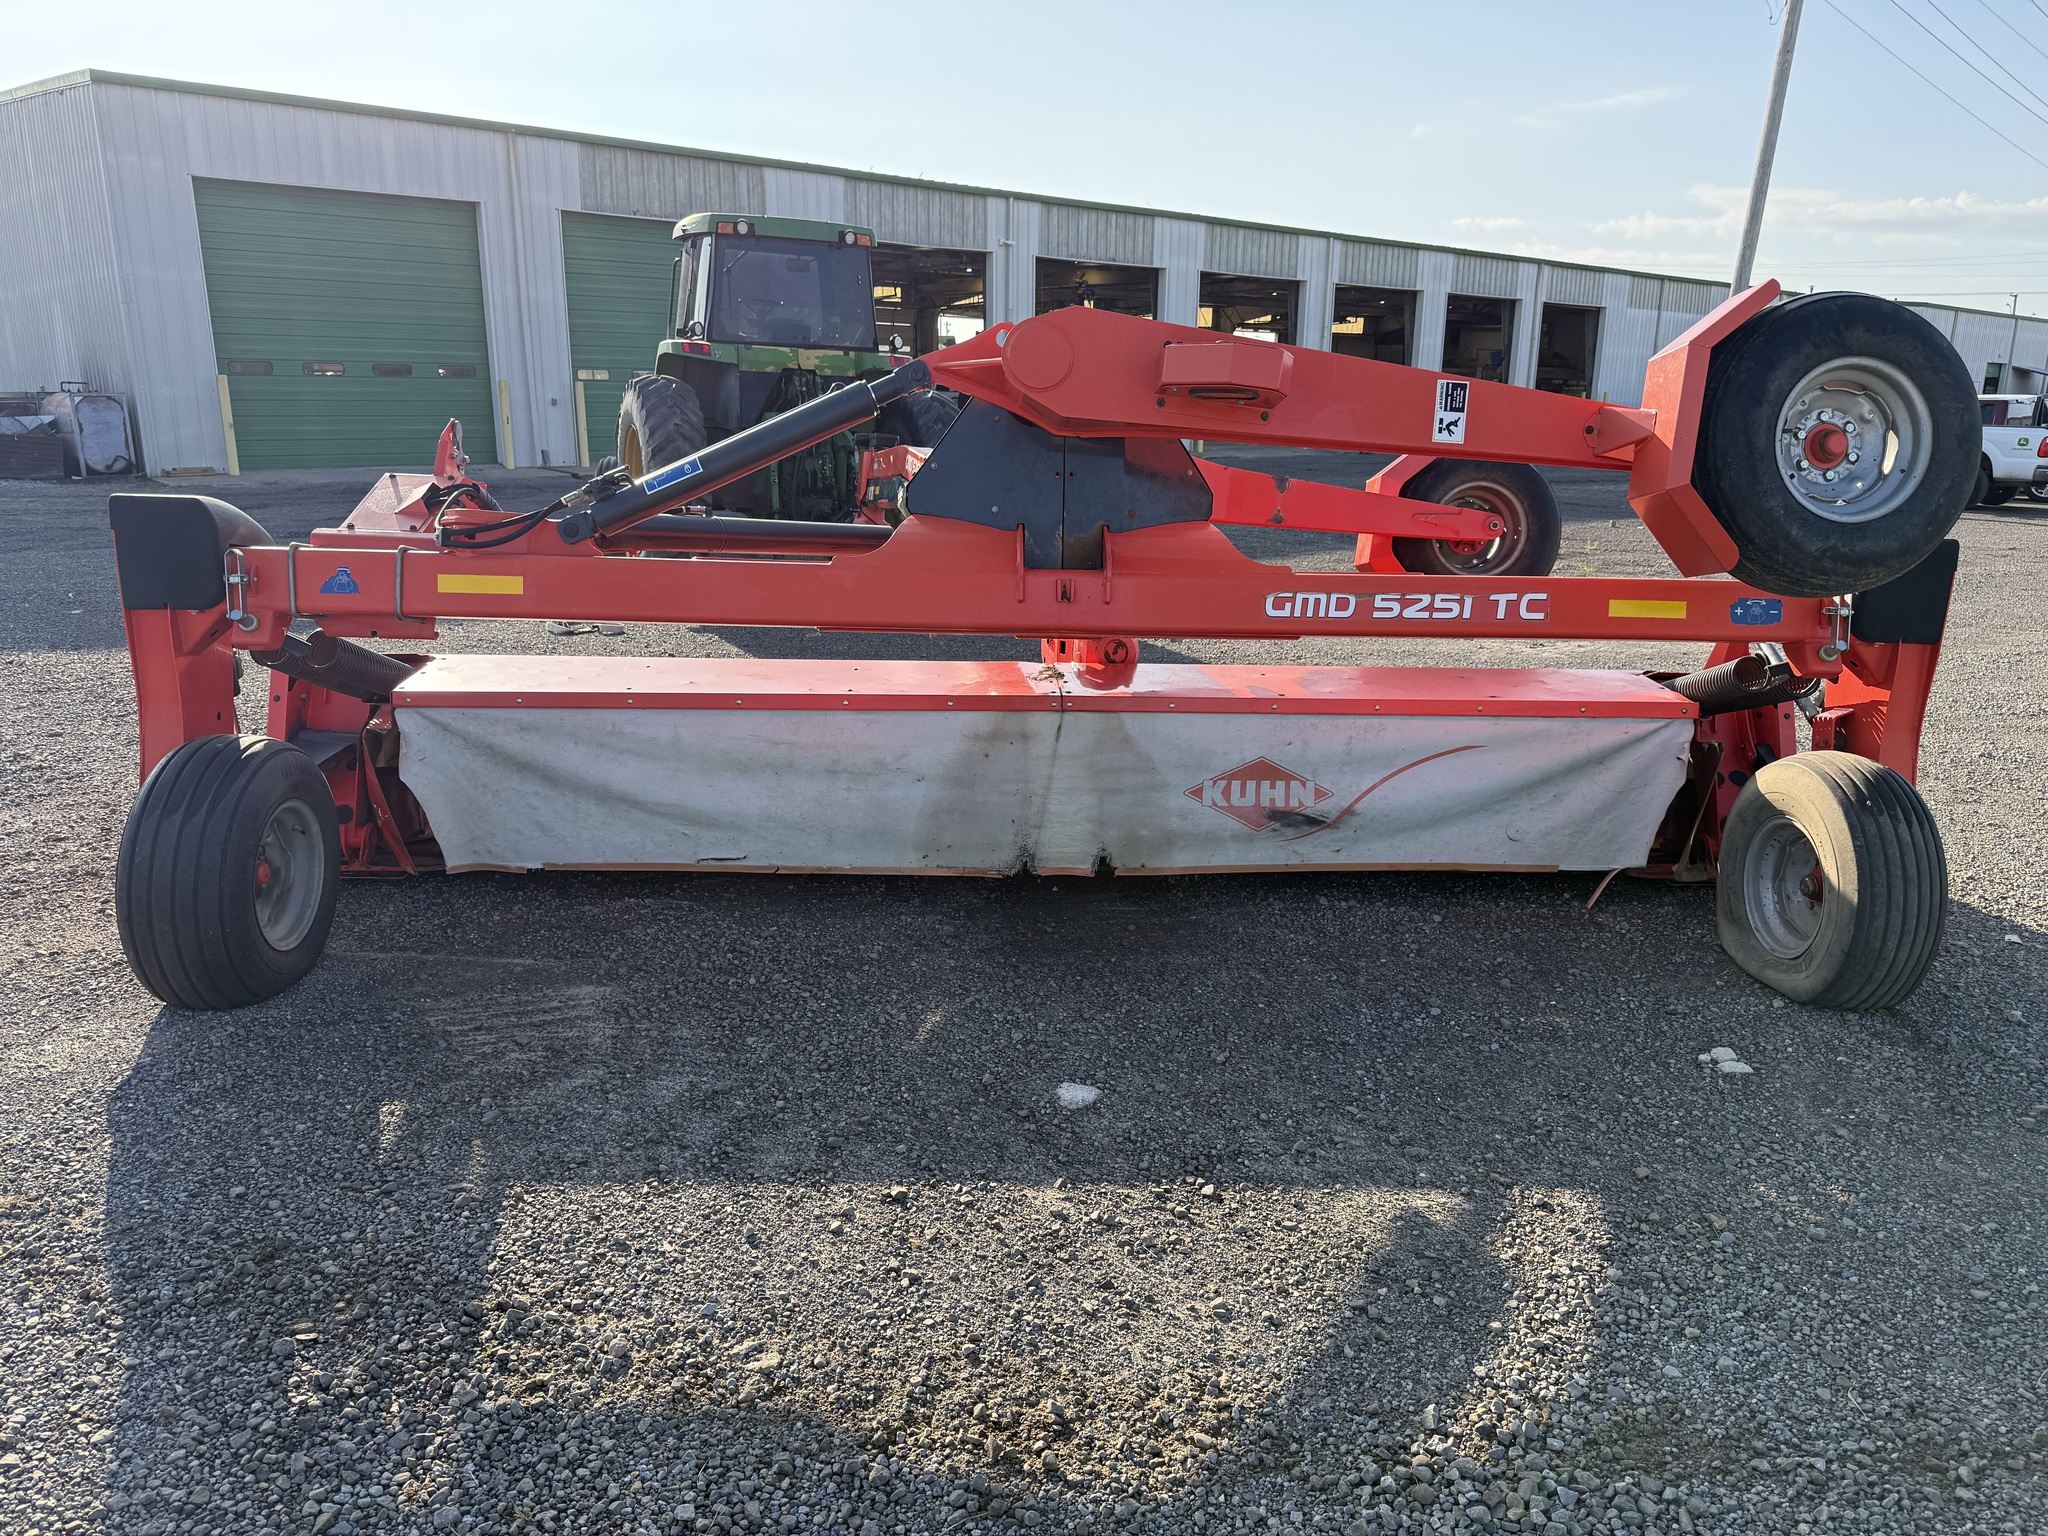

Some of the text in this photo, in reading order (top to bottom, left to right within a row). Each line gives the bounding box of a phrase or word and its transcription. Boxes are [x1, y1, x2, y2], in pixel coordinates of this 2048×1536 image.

[1265, 592, 1548, 620] GMD 5251 TC
[1202, 779, 1316, 807] KUHN
